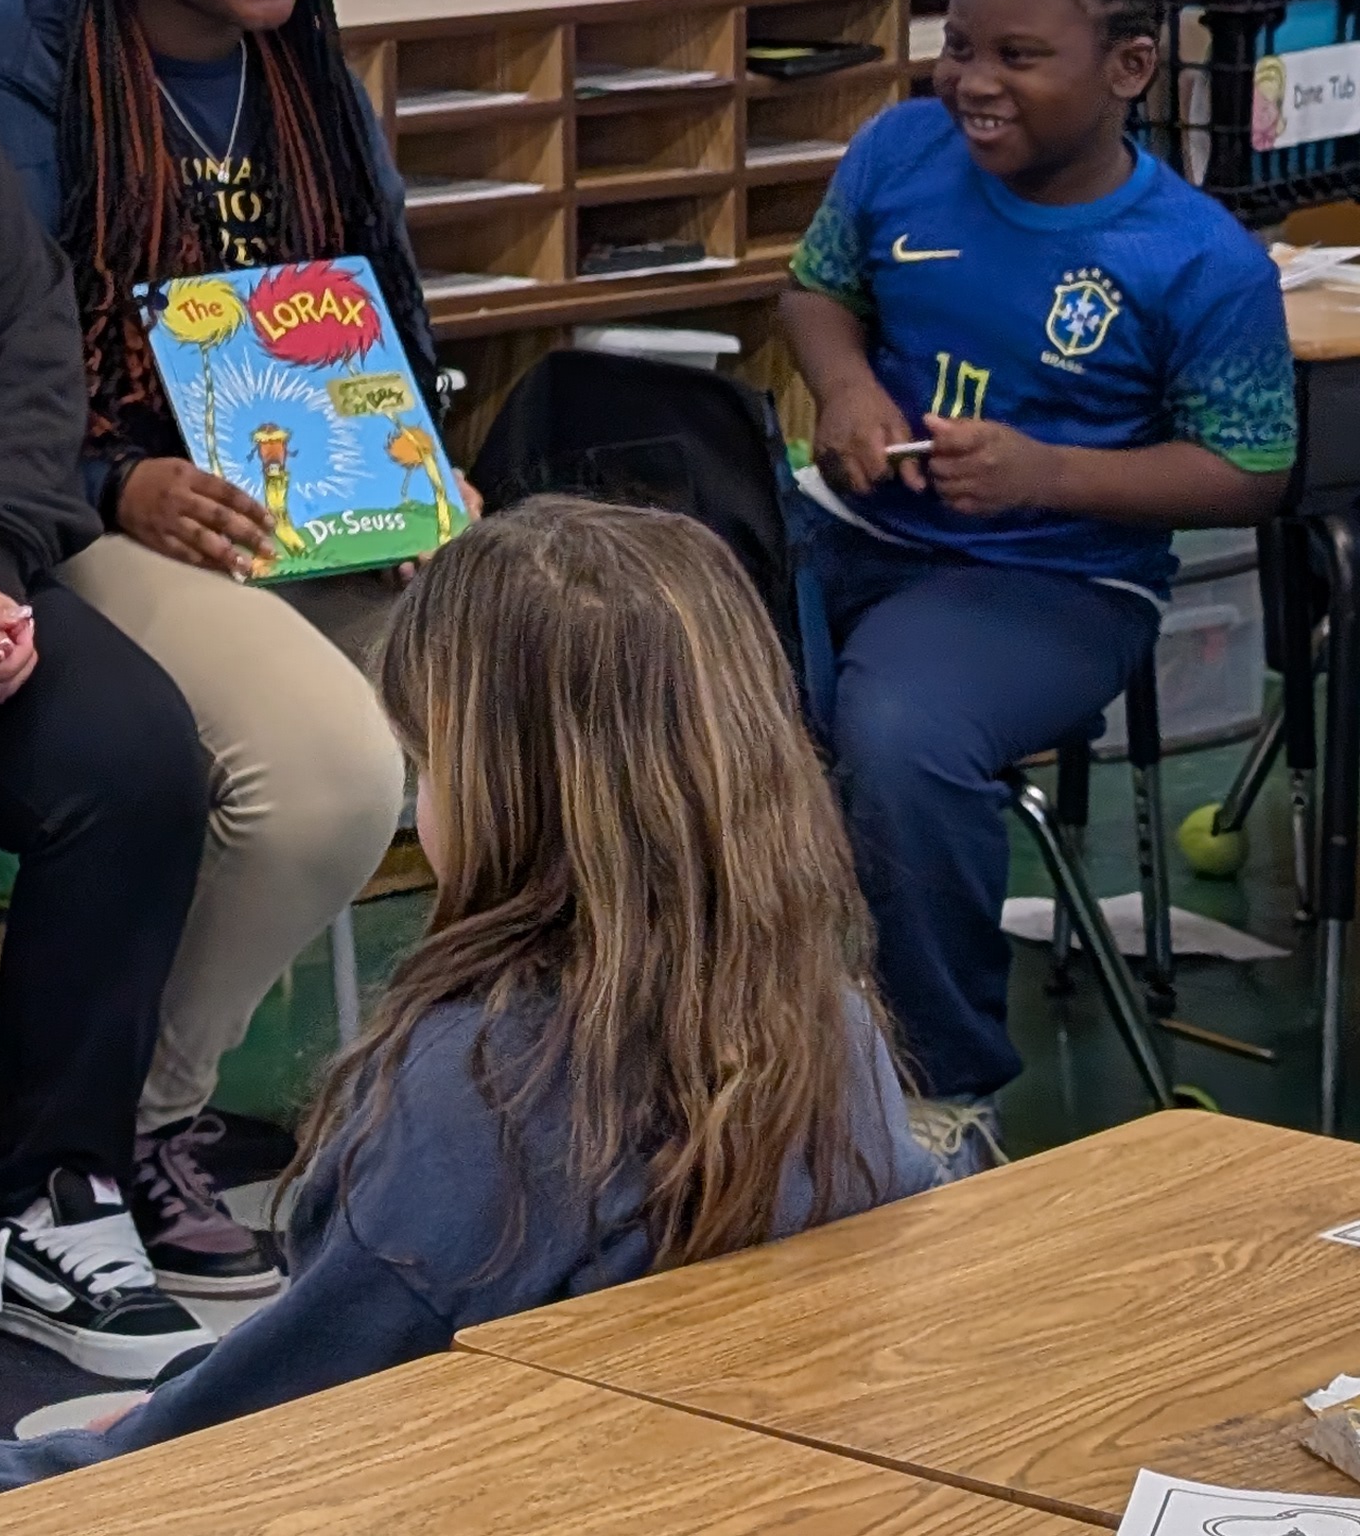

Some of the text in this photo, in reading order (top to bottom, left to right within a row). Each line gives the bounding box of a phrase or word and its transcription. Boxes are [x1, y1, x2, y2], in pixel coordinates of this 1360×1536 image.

[1329, 74, 1355, 99] Tub
[176, 288, 367, 341] The LORAX
[304, 510, 405, 545] Dr. Seuss
